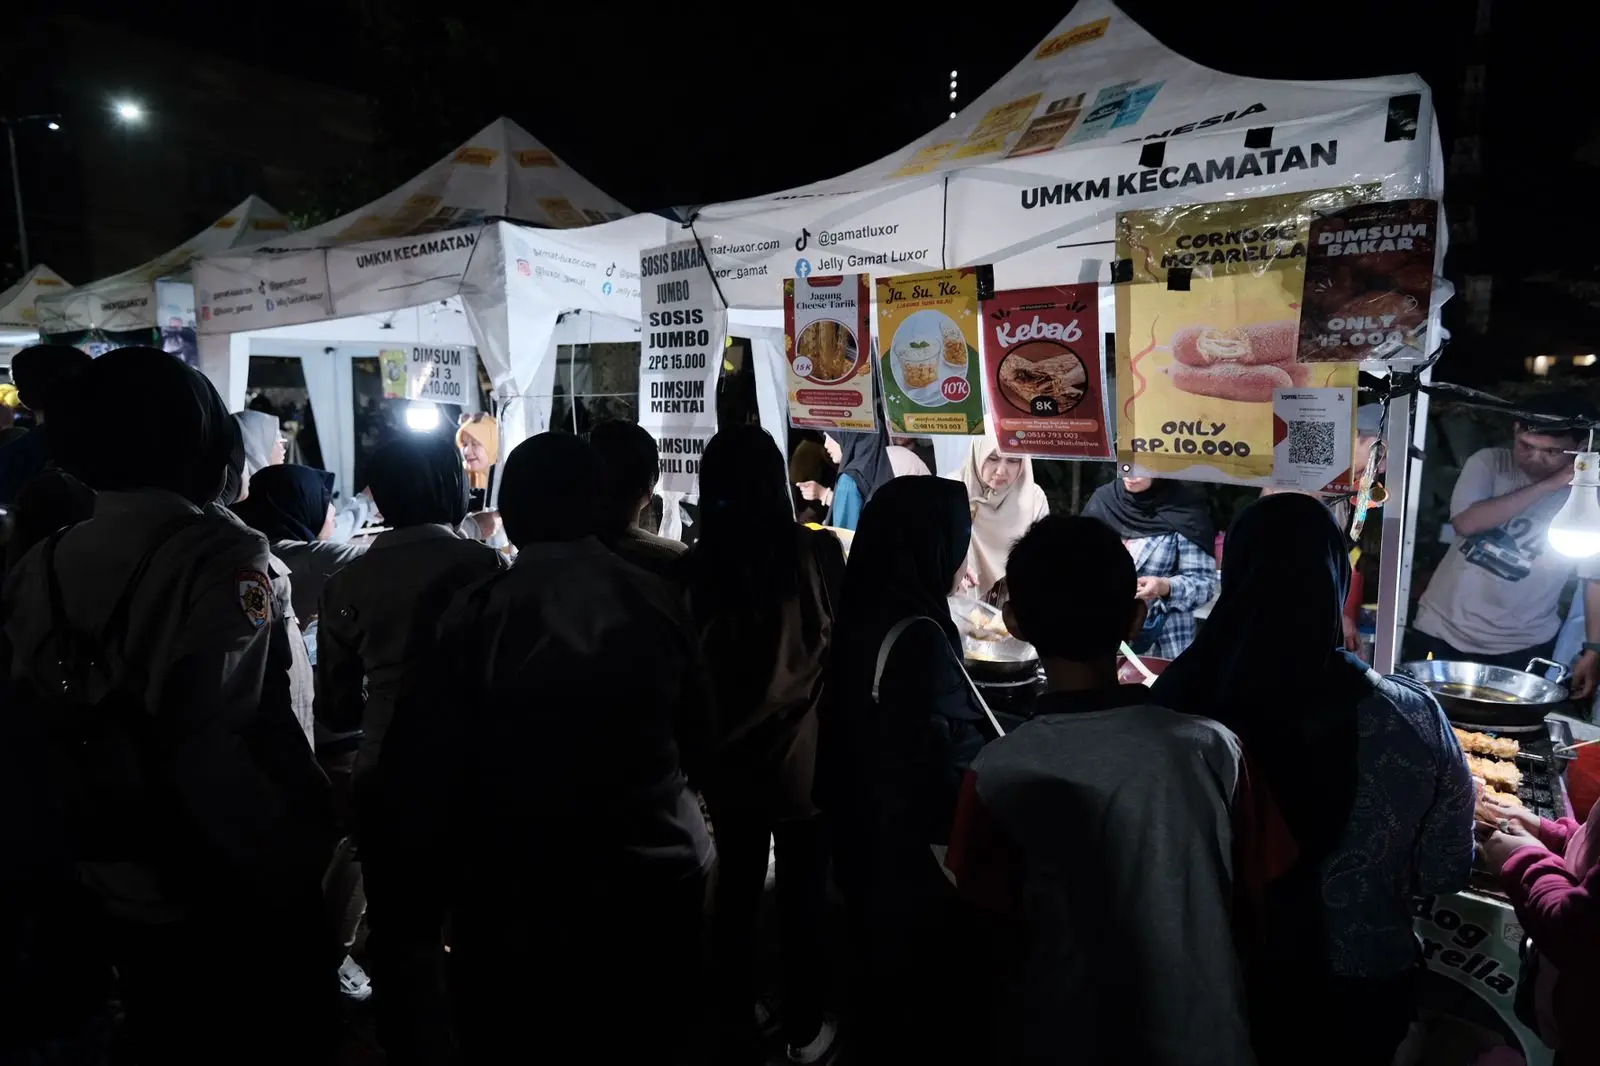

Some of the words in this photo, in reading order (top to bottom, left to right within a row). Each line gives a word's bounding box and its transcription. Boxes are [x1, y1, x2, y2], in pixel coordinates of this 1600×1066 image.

[1121, 102, 1267, 144] NESIA
[1020, 176, 1110, 209] UMKM
[1115, 140, 1339, 197] KECAMATAN
[818, 224, 899, 246] @gamatluxor
[1318, 223, 1427, 245] DIMSUM
[356, 249, 393, 268] UMKM
[394, 233, 475, 262] KECAMATAN
[1160, 242, 1306, 269] MOZARELLA
[1327, 237, 1414, 257] BAKAR
[641, 252, 669, 277] SOSIS
[817, 257, 843, 271] Jelly
[847, 252, 888, 267] Gamat
[891, 248, 929, 263] Luxor
[713, 264, 768, 280] xor_gamat
[656, 279, 690, 305] JUMBO
[809, 291, 842, 301] Jagung
[886, 288, 906, 304] Ja.
[912, 285, 933, 299] Su.
[938, 281, 961, 297] Ke.
[796, 301, 827, 310] Cheese
[649, 308, 704, 327] SOSIS
[1327, 312, 1396, 331] ONLY
[649, 329, 709, 349] JUMBO
[996, 315, 1082, 348] Kebab
[413, 347, 461, 366] DIMSUM
[648, 354, 668, 370] 2PC
[671, 353, 706, 370] 15.000
[444, 368, 452, 380] 3
[651, 380, 704, 398] DIMSUM
[943, 381, 967, 395] 10K
[651, 400, 704, 414] MENTAI
[1035, 401, 1053, 411] 8K
[1161, 421, 1226, 436] ONLY
[657, 438, 705, 455] IMSUM
[659, 458, 682, 473] HILI
[685, 459, 700, 474] OI
